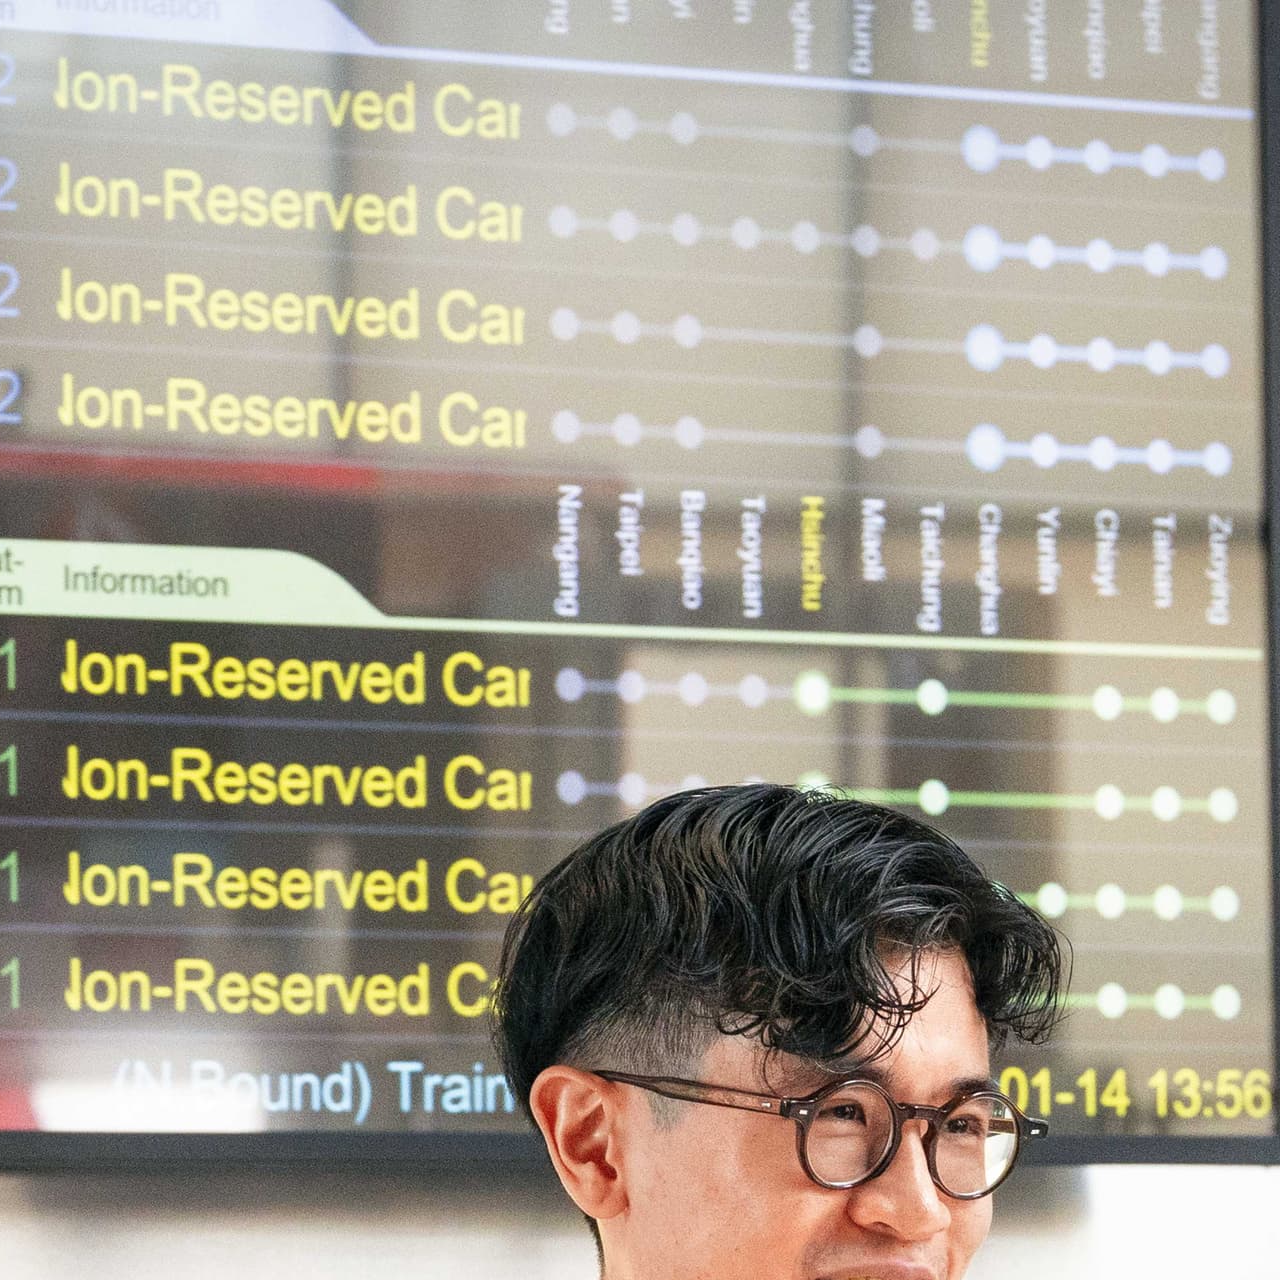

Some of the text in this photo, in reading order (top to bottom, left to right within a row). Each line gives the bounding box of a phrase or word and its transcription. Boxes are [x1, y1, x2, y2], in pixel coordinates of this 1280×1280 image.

[64, 565, 229, 598] Information
[553, 484, 580, 617] Nangang
[615, 489, 643, 576] Taipei
[677, 489, 705, 609] Banqiao
[737, 496, 765, 618] Taoyuan
[802, 496, 823, 611] Hsinchu
[861, 498, 885, 582] Miaoli
[918, 503, 944, 632] Taichung
[977, 503, 1002, 634] Changhua
[1037, 508, 1062, 594] Yunlin
[1093, 508, 1119, 598] Chiayi
[1152, 514, 1175, 609] Tainan
[1204, 517, 1232, 626] Zuoying
[1148, 1067, 1273, 1119] 13:56
